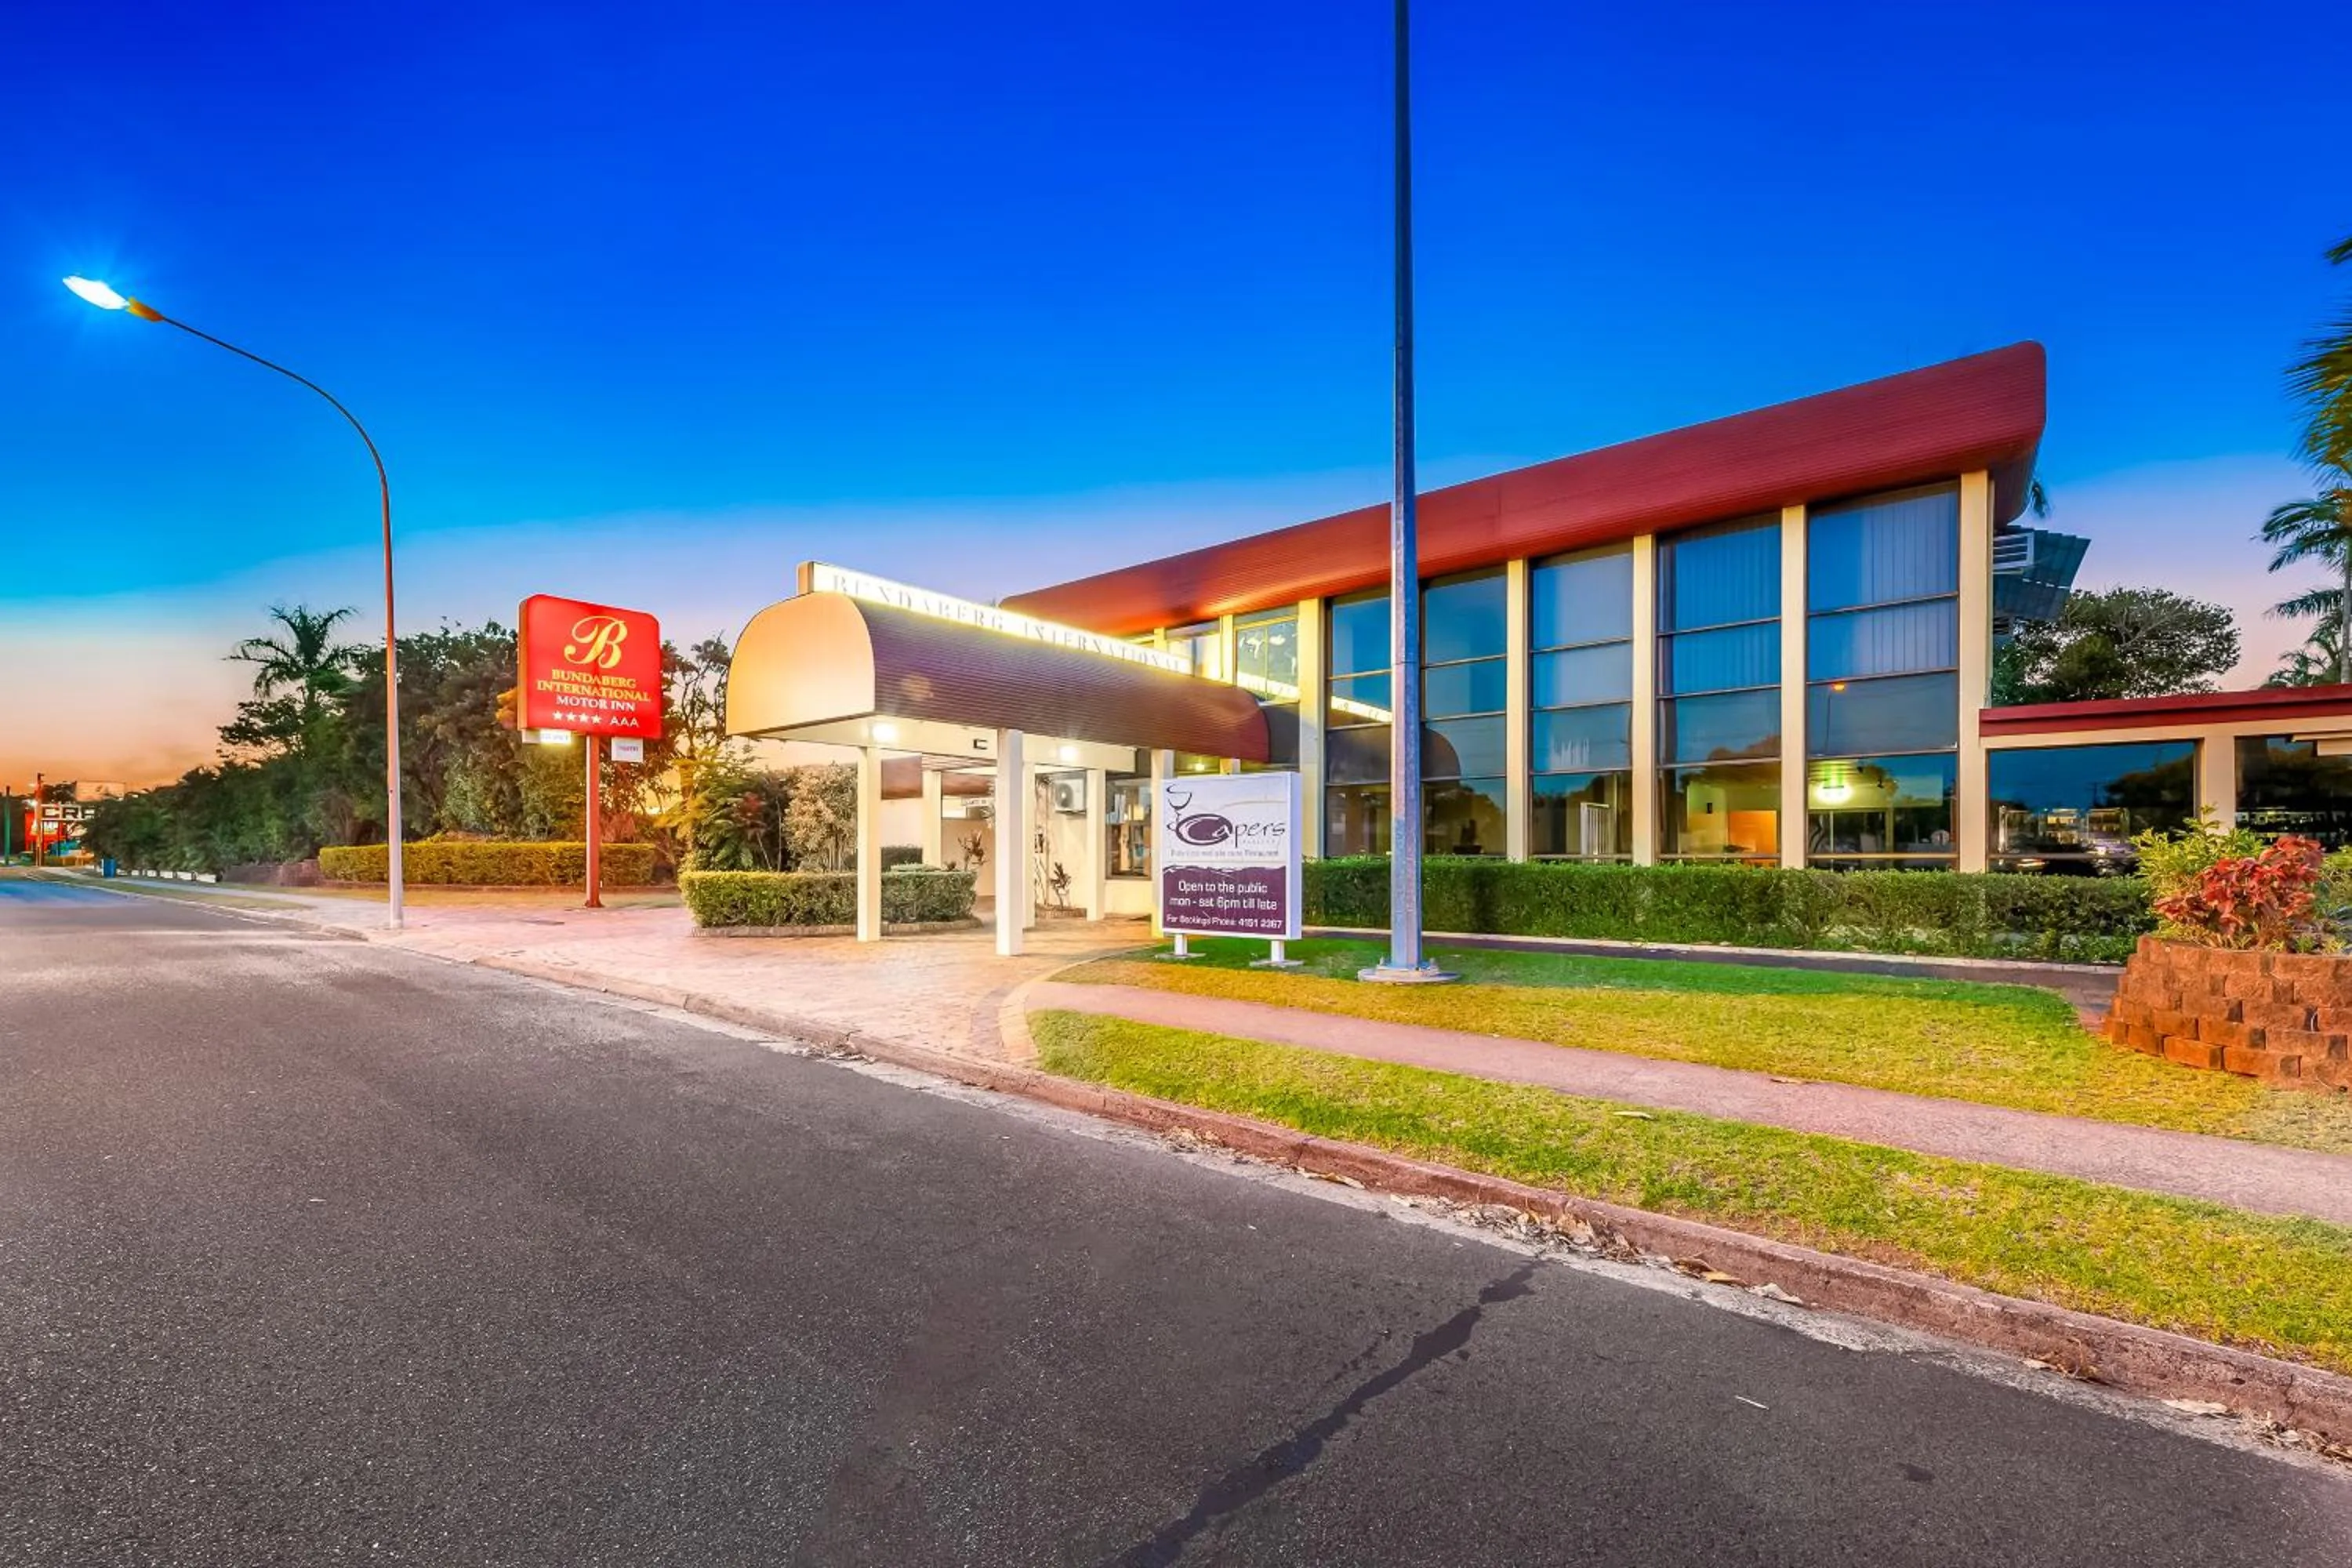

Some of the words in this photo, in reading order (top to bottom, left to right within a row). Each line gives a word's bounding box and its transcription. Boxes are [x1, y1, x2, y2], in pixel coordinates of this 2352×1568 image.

[564, 615, 628, 669] B
[551, 669, 637, 688] BUNDABERG
[536, 680, 652, 702] INTERNATIONAL
[556, 695, 608, 710] MOTOR
[611, 700, 636, 712] INN
[609, 716, 640, 728] AAA
[1178, 880, 1203, 894] Open
[1205, 882, 1216, 892] to
[1218, 880, 1235, 893] the
[1238, 882, 1268, 896] public
[1169, 898, 1191, 907] mon
[1199, 898, 1214, 908] sat
[1243, 898, 1255, 909] till
[1257, 898, 1277, 910] late
